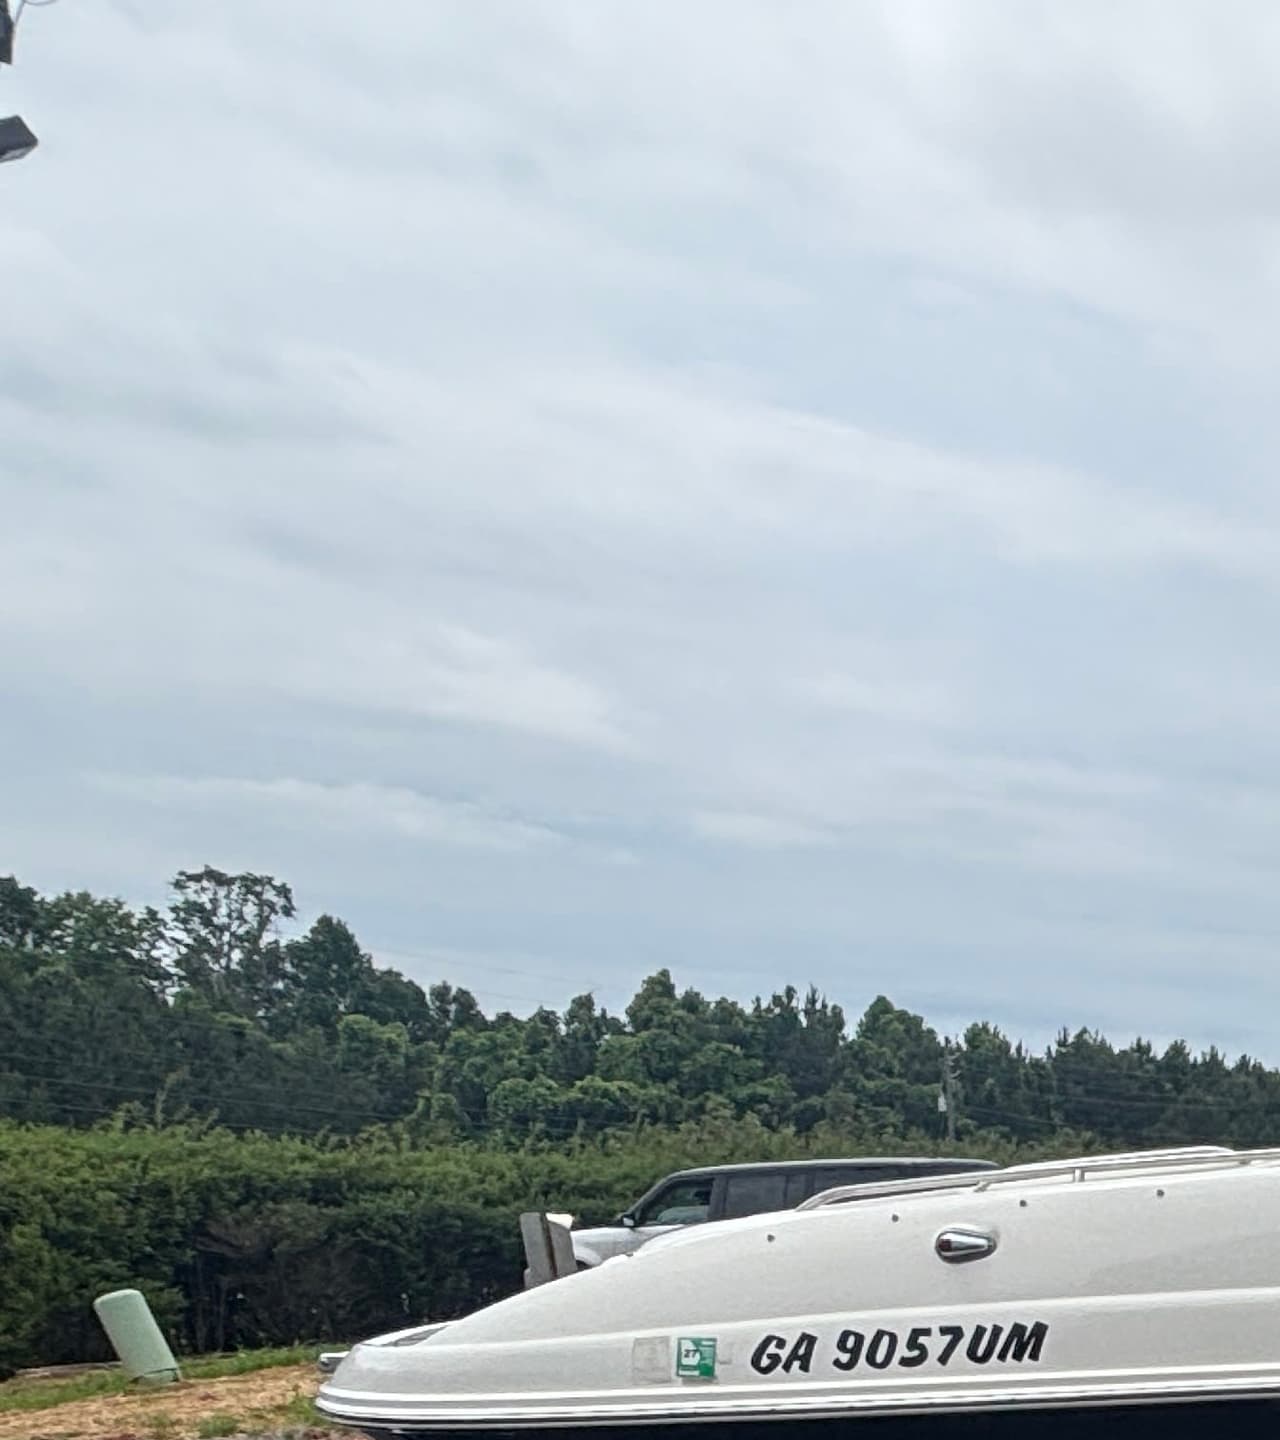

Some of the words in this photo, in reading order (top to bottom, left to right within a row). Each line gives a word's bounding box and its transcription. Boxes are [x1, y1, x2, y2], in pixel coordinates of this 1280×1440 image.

[684, 1348, 700, 1358] 27
[750, 1331, 819, 1376] GA
[832, 1321, 1050, 1371] 9057UM
